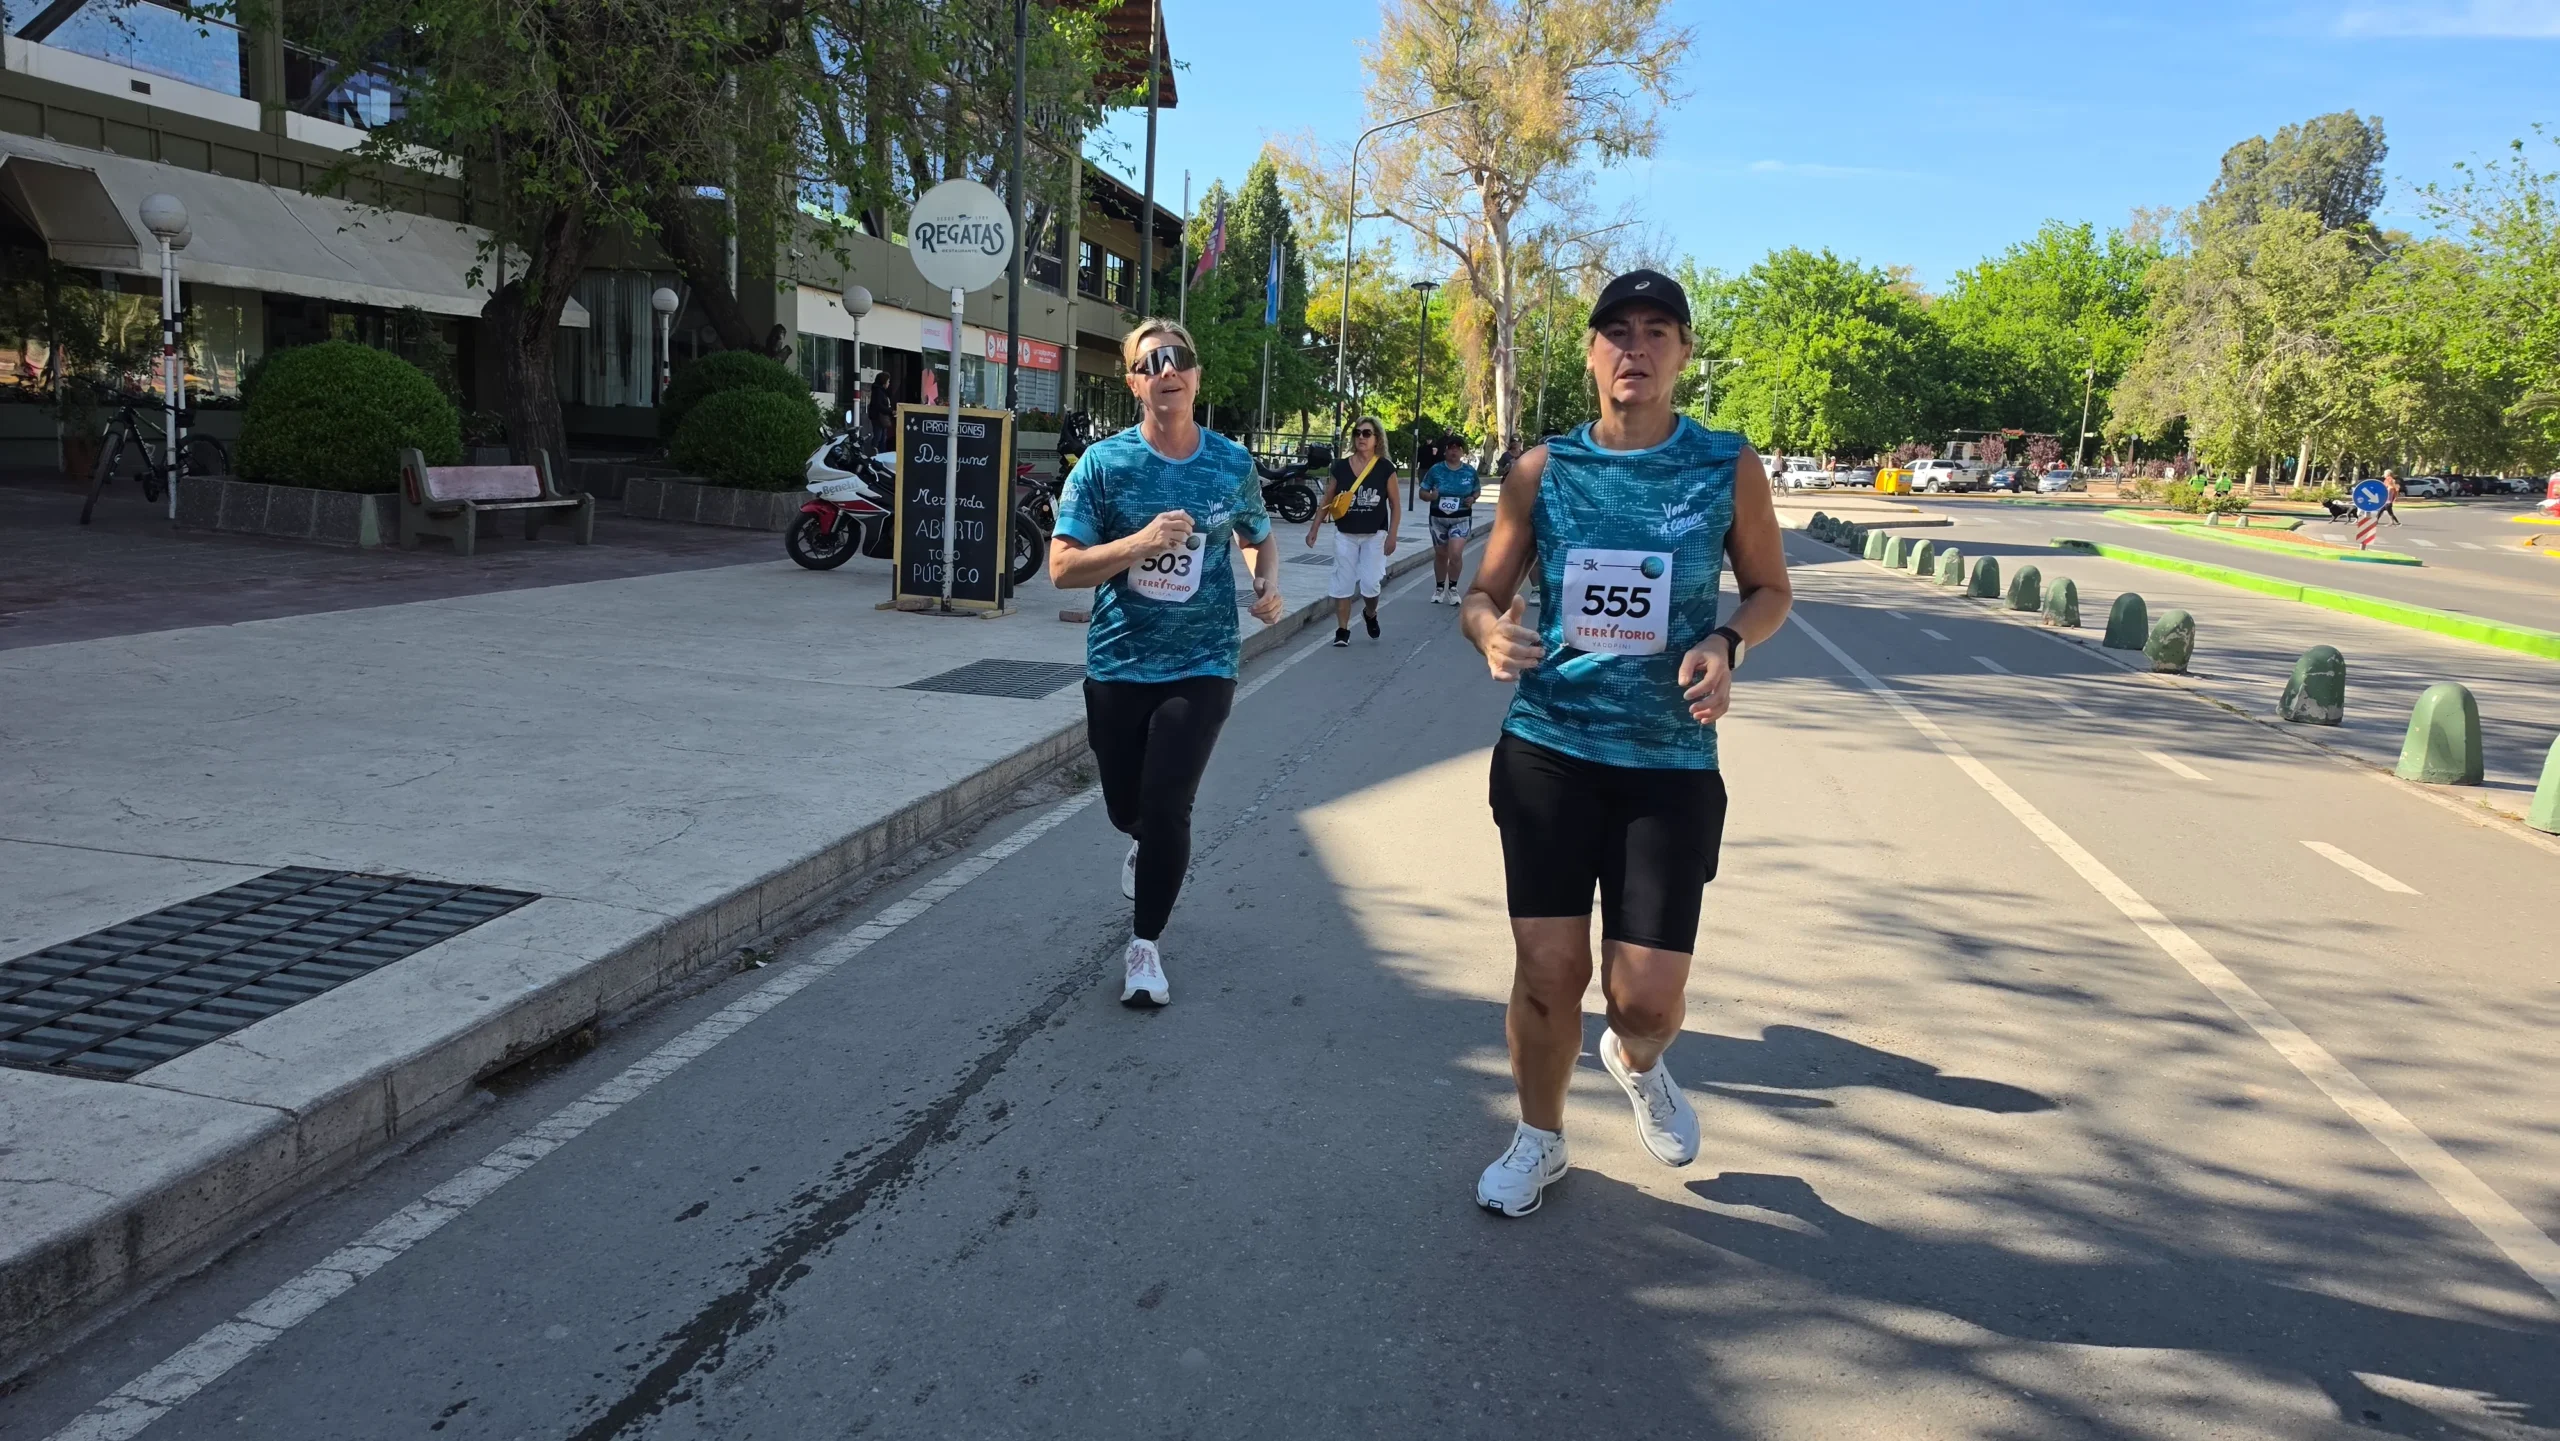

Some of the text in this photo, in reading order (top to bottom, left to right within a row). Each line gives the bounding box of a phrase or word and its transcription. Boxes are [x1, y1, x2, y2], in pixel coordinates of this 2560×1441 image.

[915, 222, 1004, 255] REGATAS
[925, 420, 983, 436] PROIONES
[914, 443, 989, 472] Desyuno
[822, 480, 859, 495] Benelli
[912, 488, 985, 509] Merenda
[915, 517, 984, 541] ABIRTO
[928, 549, 960, 560] TOO
[1141, 553, 1192, 577] 503
[913, 562, 979, 583] PÚBCO
[1138, 578, 1191, 592] TERRITORIO
[1581, 585, 1652, 618] 555
[1576, 623, 1656, 641] TERRITORIO
[1592, 641, 1631, 650] YACOPINI
